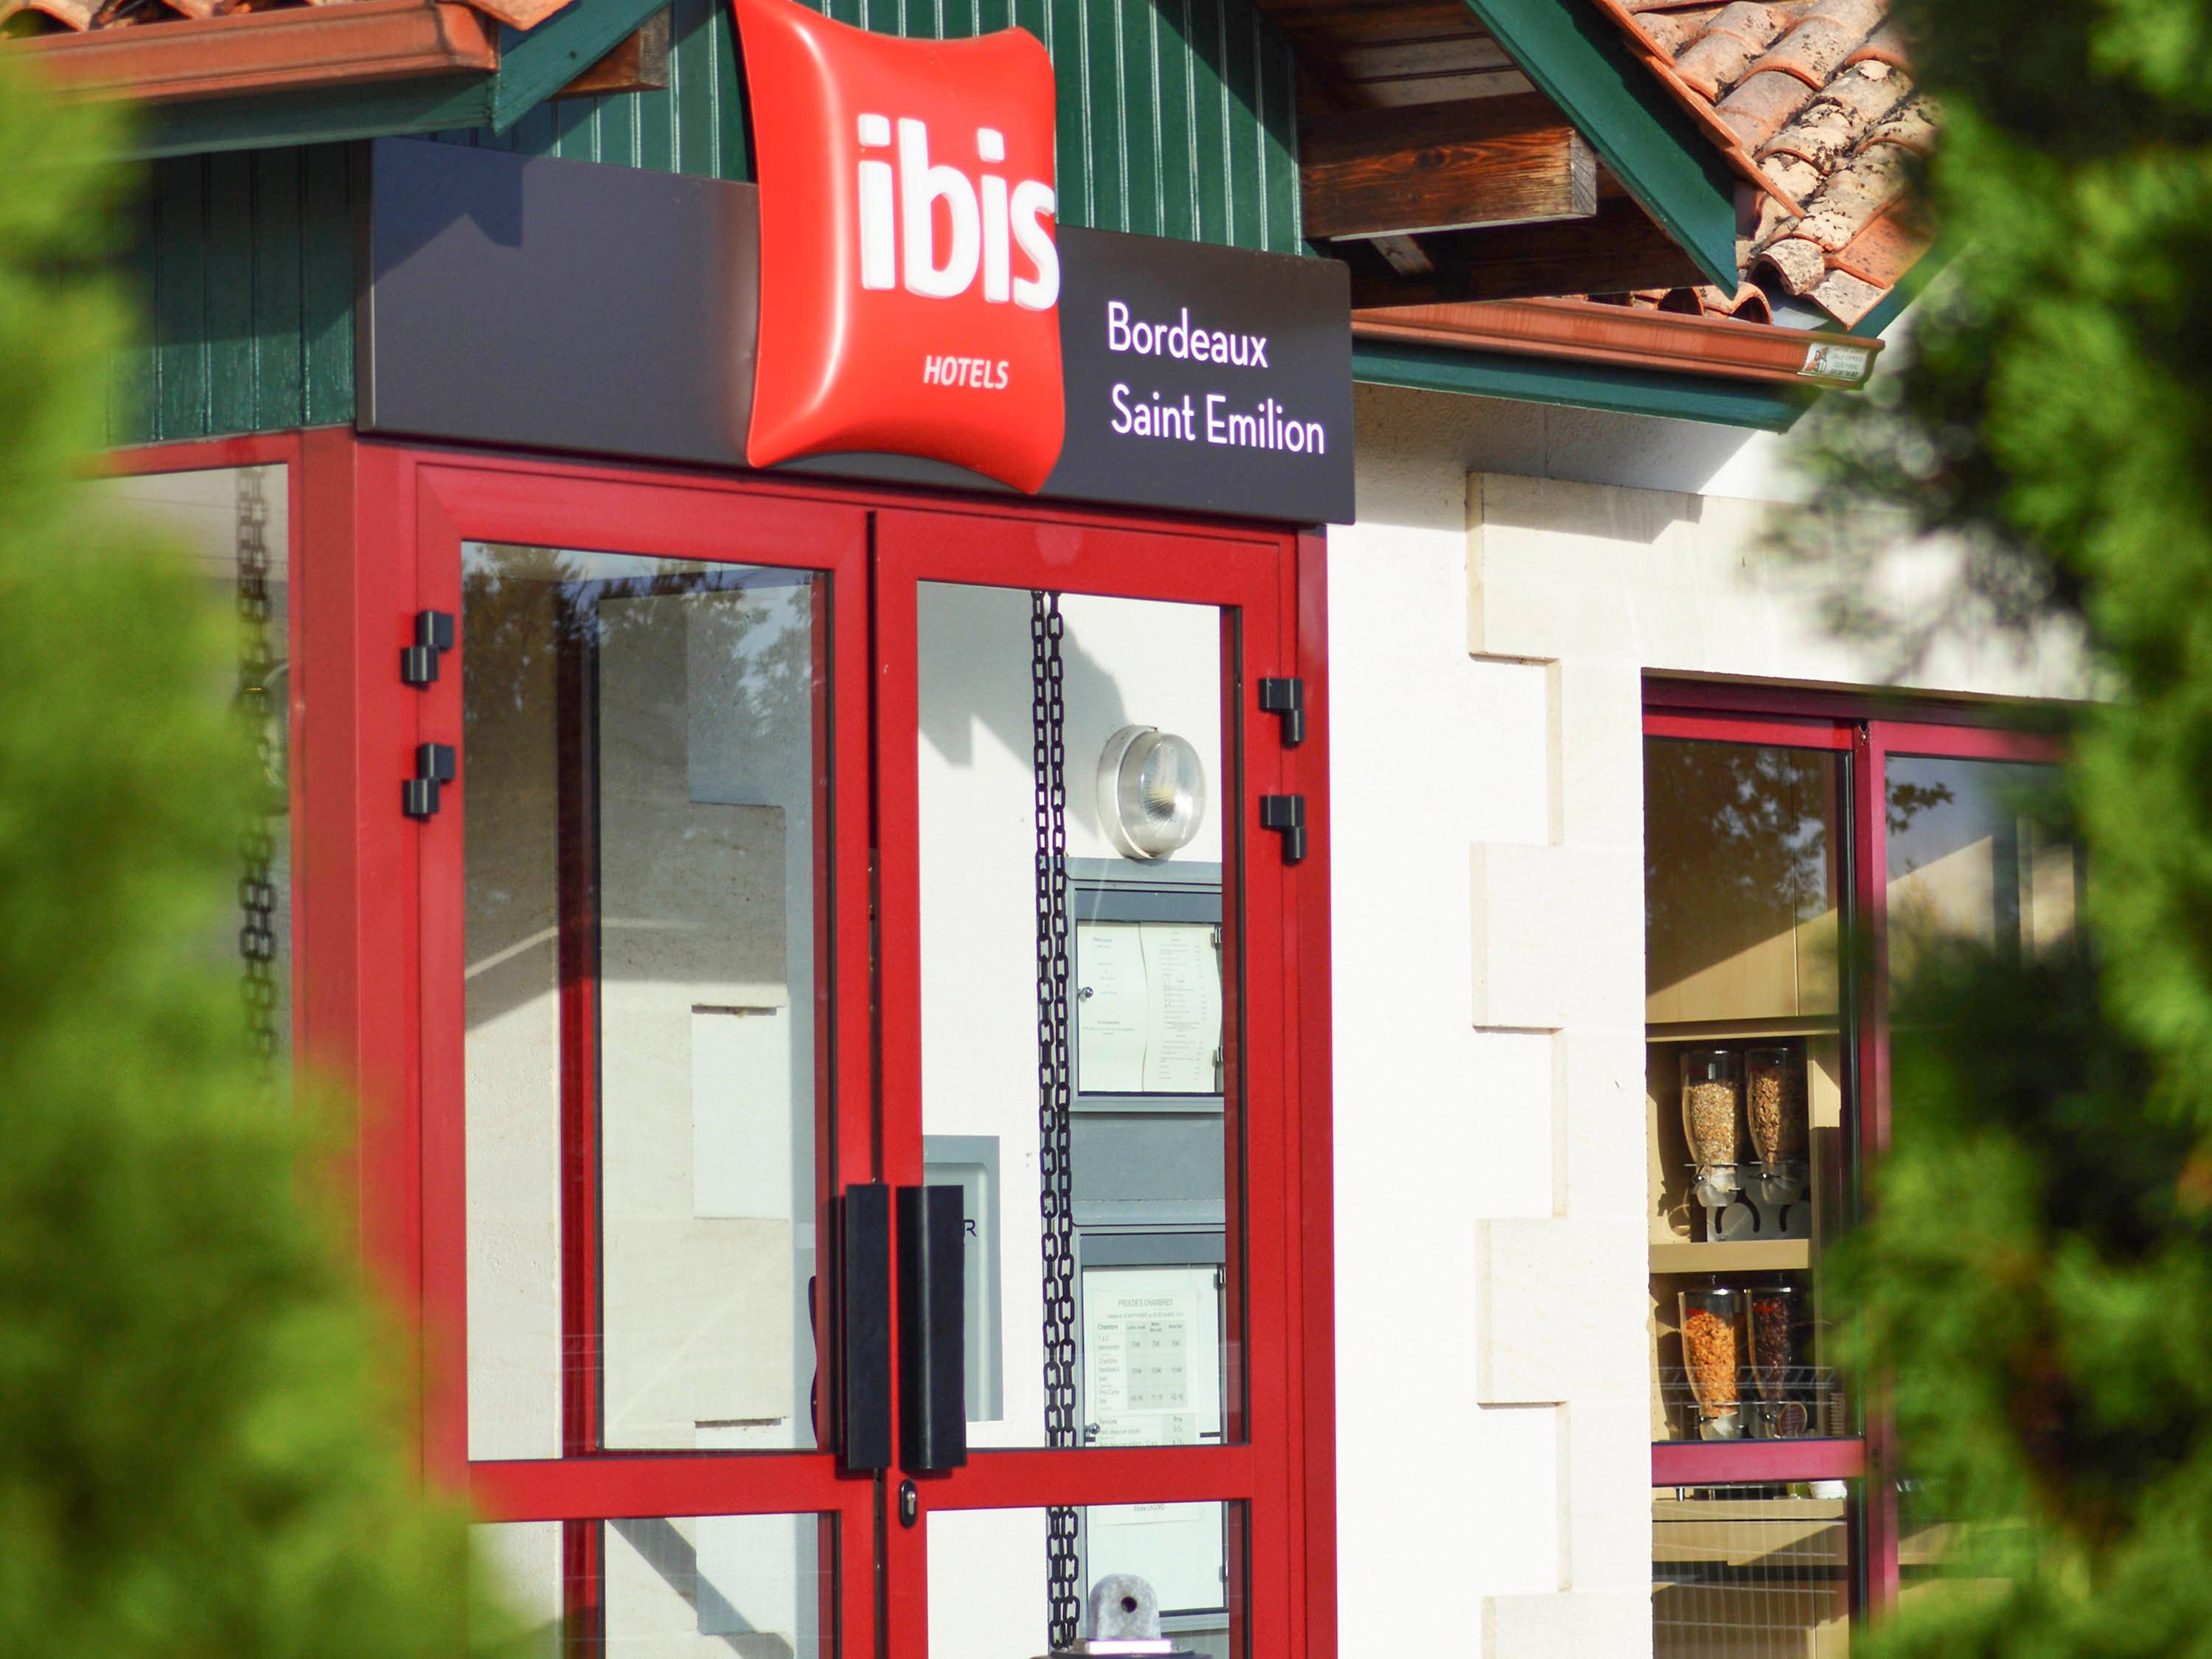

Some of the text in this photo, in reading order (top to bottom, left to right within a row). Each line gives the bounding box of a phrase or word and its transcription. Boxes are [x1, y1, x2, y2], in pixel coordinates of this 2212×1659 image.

[858, 114, 1060, 312] ibis
[1107, 300, 1268, 369] Bordeaux
[923, 355, 1009, 390] HOTELS
[1111, 383, 1325, 455] Saint Emilion
